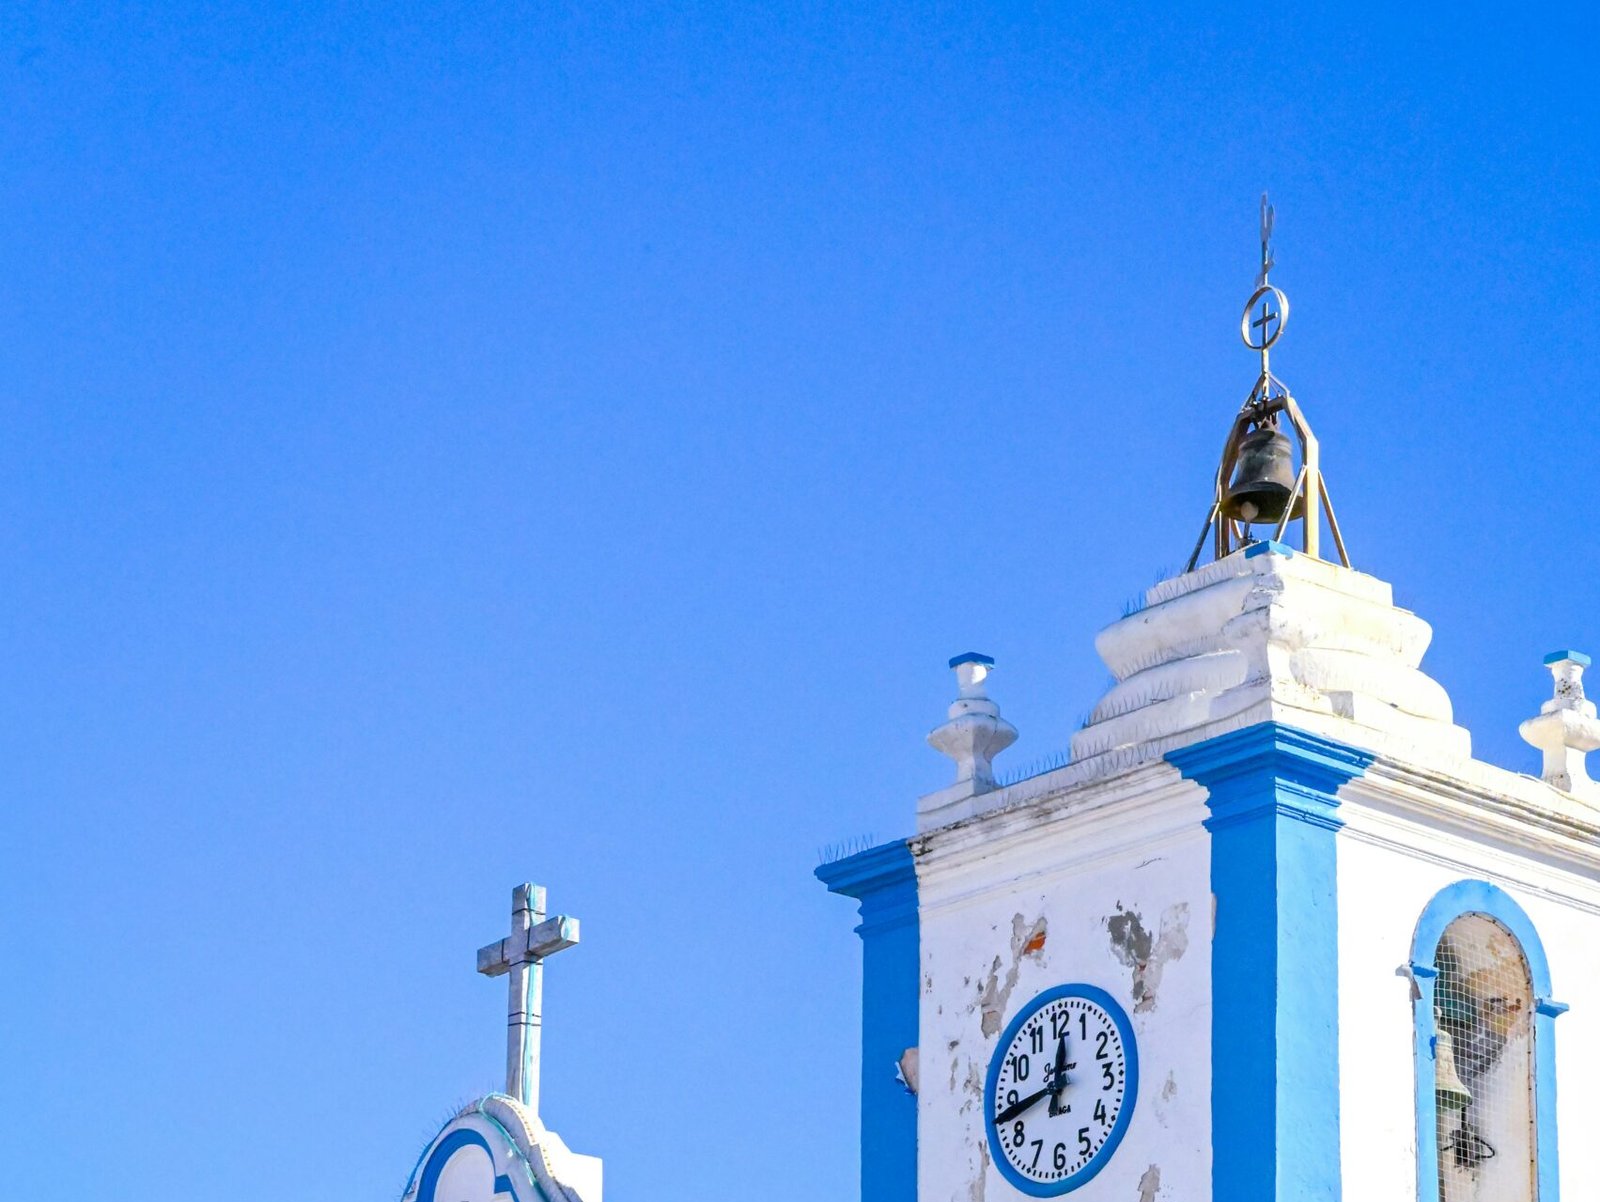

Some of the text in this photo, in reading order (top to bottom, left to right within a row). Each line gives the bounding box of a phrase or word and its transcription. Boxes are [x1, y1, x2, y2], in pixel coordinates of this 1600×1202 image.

[1029, 1025, 1044, 1054] 11
[1050, 1010, 1070, 1040] 12
[1079, 1013, 1087, 1040] 1
[1096, 1031, 1109, 1060] 2
[1011, 1054, 1030, 1083] 10
[1102, 1061, 1114, 1091] 3
[1007, 1089, 1019, 1107] 9
[1093, 1099, 1107, 1125] 4
[1012, 1120, 1025, 1148] 8
[1078, 1127, 1091, 1156] 5
[1030, 1139, 1044, 1169] 7
[1053, 1142, 1067, 1170] 6
